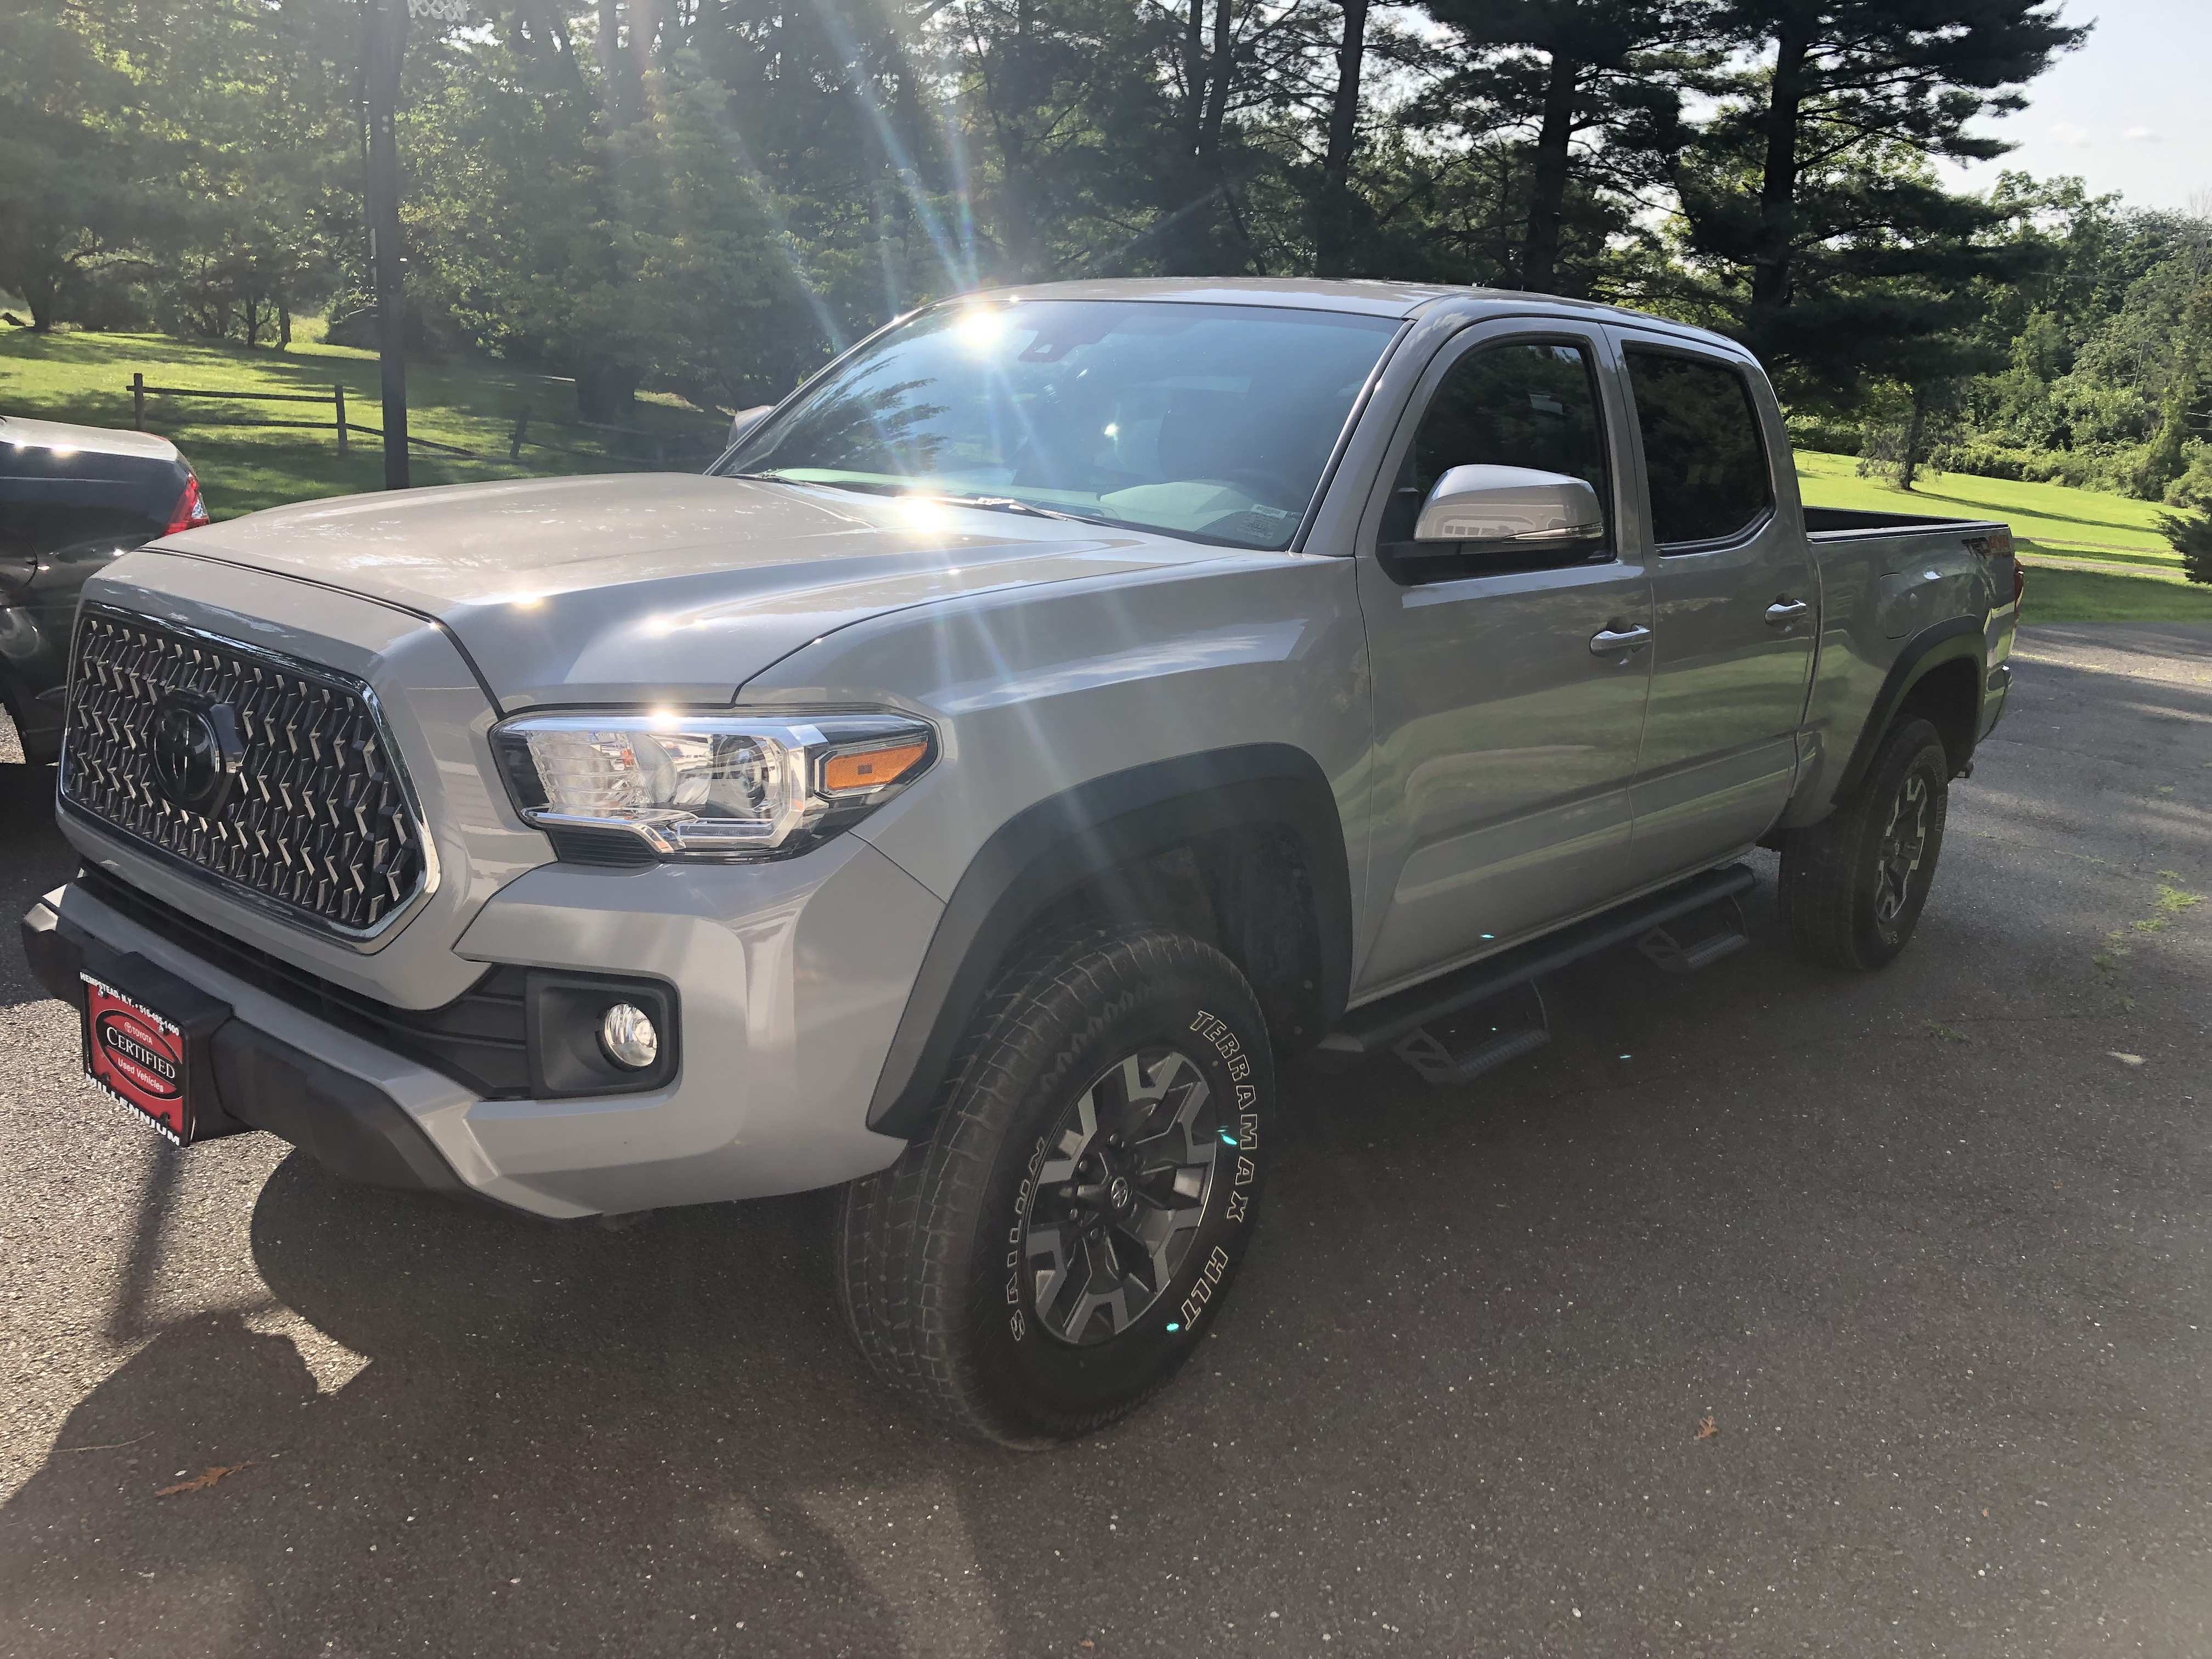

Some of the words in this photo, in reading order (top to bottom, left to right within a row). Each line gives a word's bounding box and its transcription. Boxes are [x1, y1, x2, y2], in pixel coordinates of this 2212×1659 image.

[106, 1026, 175, 1079] CERTIFIED
[132, 1026, 153, 1045] TOYOTA
[118, 1057, 134, 1074] Used
[137, 1068, 163, 1092] Vehicles
[86, 1073, 179, 1146] MILLENNIUM
[1189, 1010, 1258, 1222] TERRAMAX
[1181, 1245, 1228, 1330] HLT
